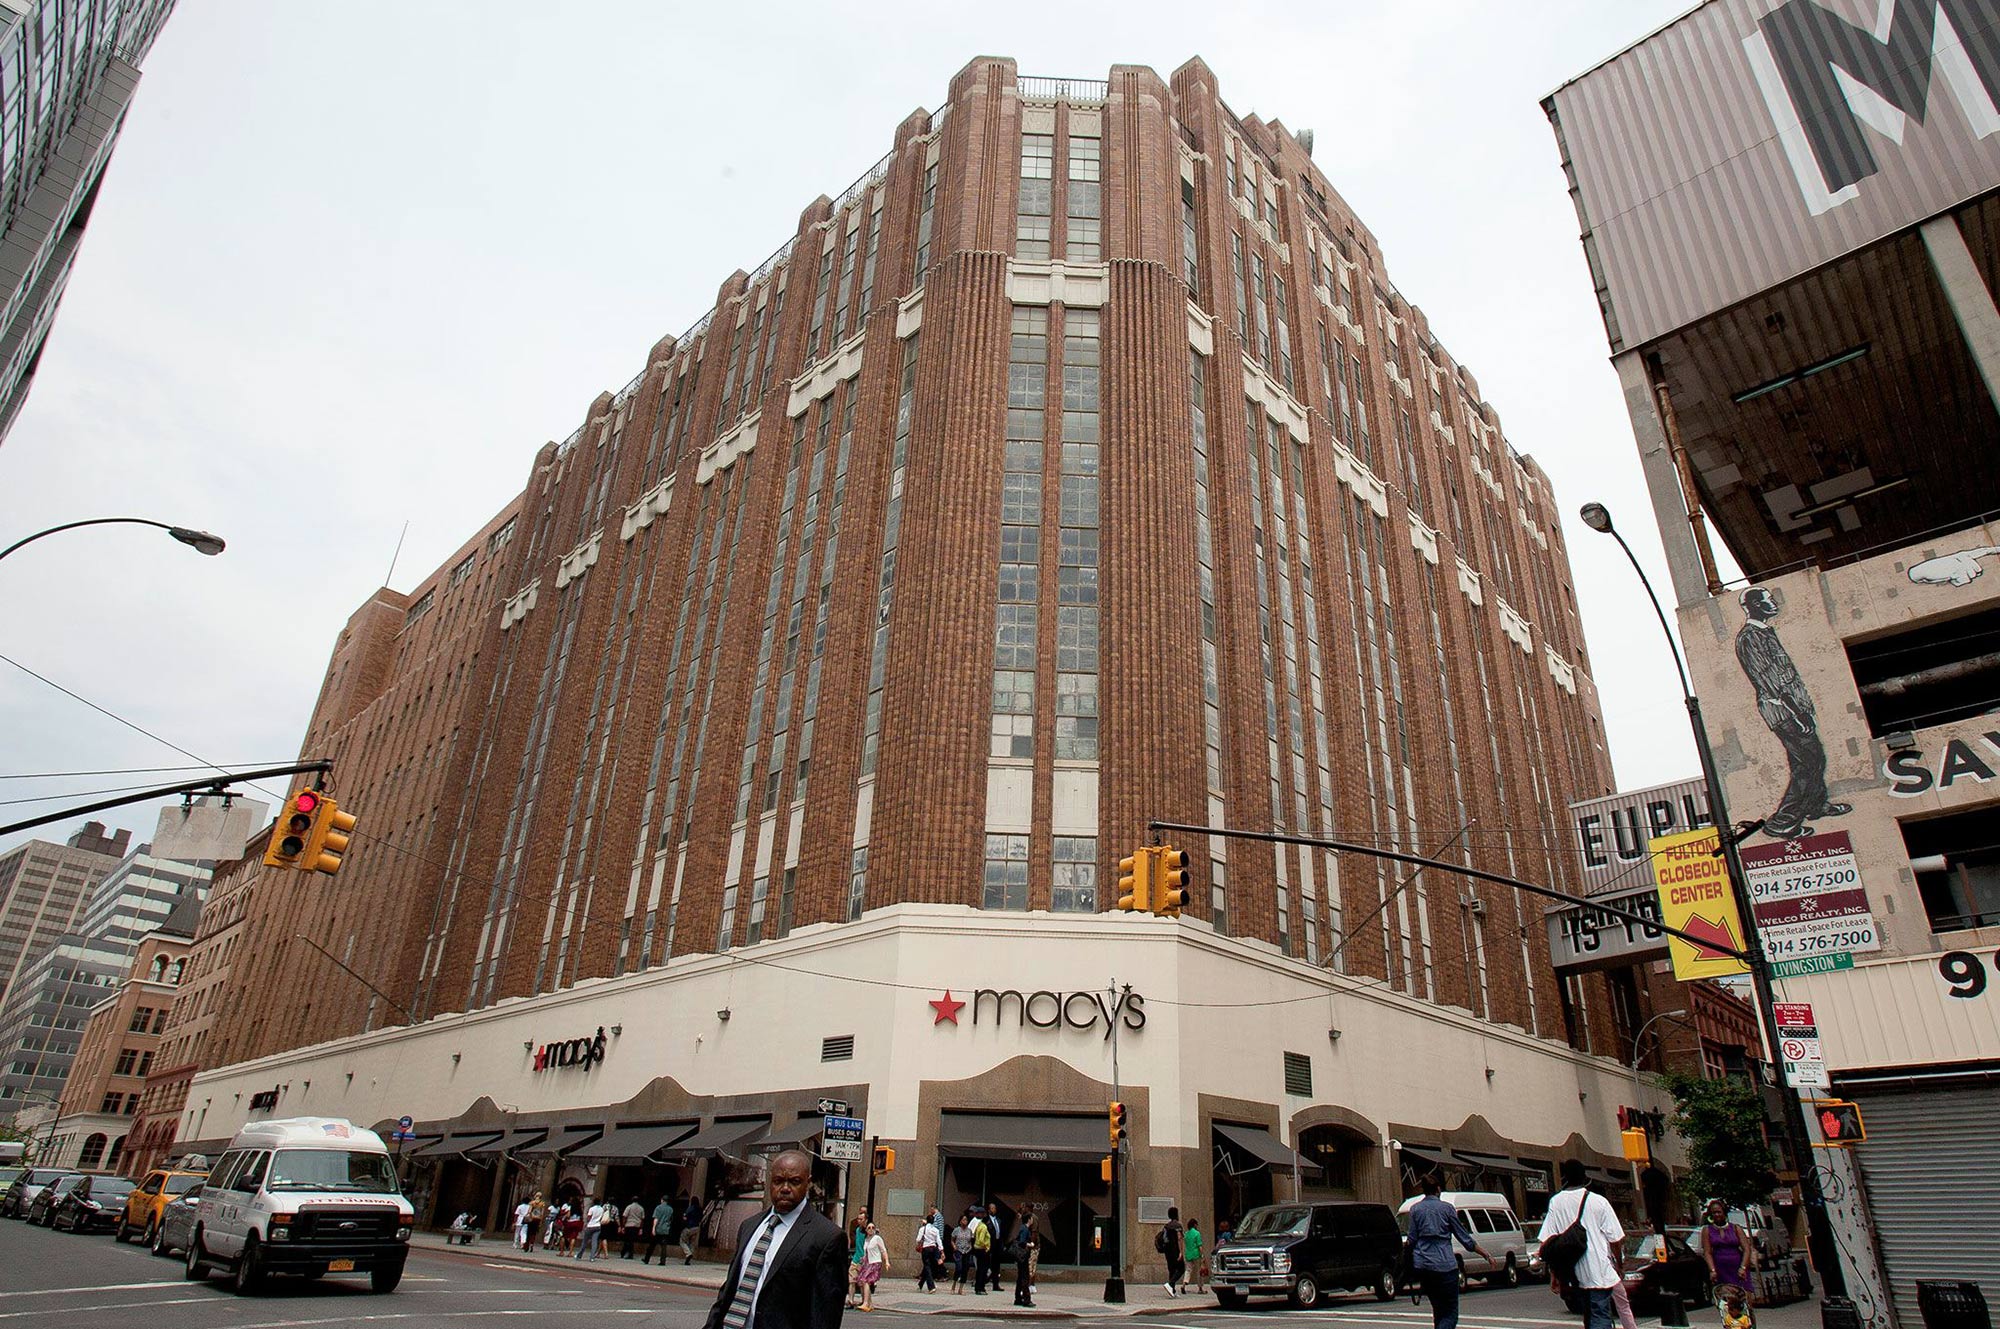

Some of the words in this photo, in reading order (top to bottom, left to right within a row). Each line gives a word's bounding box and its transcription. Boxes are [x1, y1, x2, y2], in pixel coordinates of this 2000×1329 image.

[1883, 732, 2000, 797] SA
[1665, 838, 1715, 862] FULTON
[1746, 857, 1782, 868] WELCO
[1784, 850, 1826, 863] REALTY,
[1827, 847, 1848, 856] INC.
[1659, 857, 1727, 885] CLOSEOUT
[1749, 870, 1770, 880] Prime
[1771, 867, 1791, 877] Retail
[1792, 864, 1814, 875] Space
[1815, 861, 1827, 870] For
[1828, 858, 1851, 868] Lease
[1670, 881, 1723, 905] CENTER
[1754, 881, 1779, 896] 914
[1784, 870, 1855, 892] 576-7500
[1760, 916, 1798, 926] WELCO
[1800, 909, 1842, 921] REALTY,
[1844, 906, 1866, 915] INC.
[1763, 929, 1785, 939] Prime
[1786, 925, 1807, 936] Retail
[1807, 922, 1830, 933] Space
[1831, 920, 1843, 929] For
[1845, 917, 1868, 927] Lease
[1768, 940, 1794, 955] 914
[1799, 929, 1872, 951] 576-7500
[1772, 955, 1836, 977] LIVINGSTON
[1836, 954, 1847, 962] ST
[973, 983, 1146, 1041] macy's
[543, 1026, 607, 1072] macy's
[827, 1128, 845, 1136] BUSES
[846, 1130, 860, 1138] ONLY
[834, 1119, 846, 1127] BUS
[847, 1121, 862, 1130] LANE
